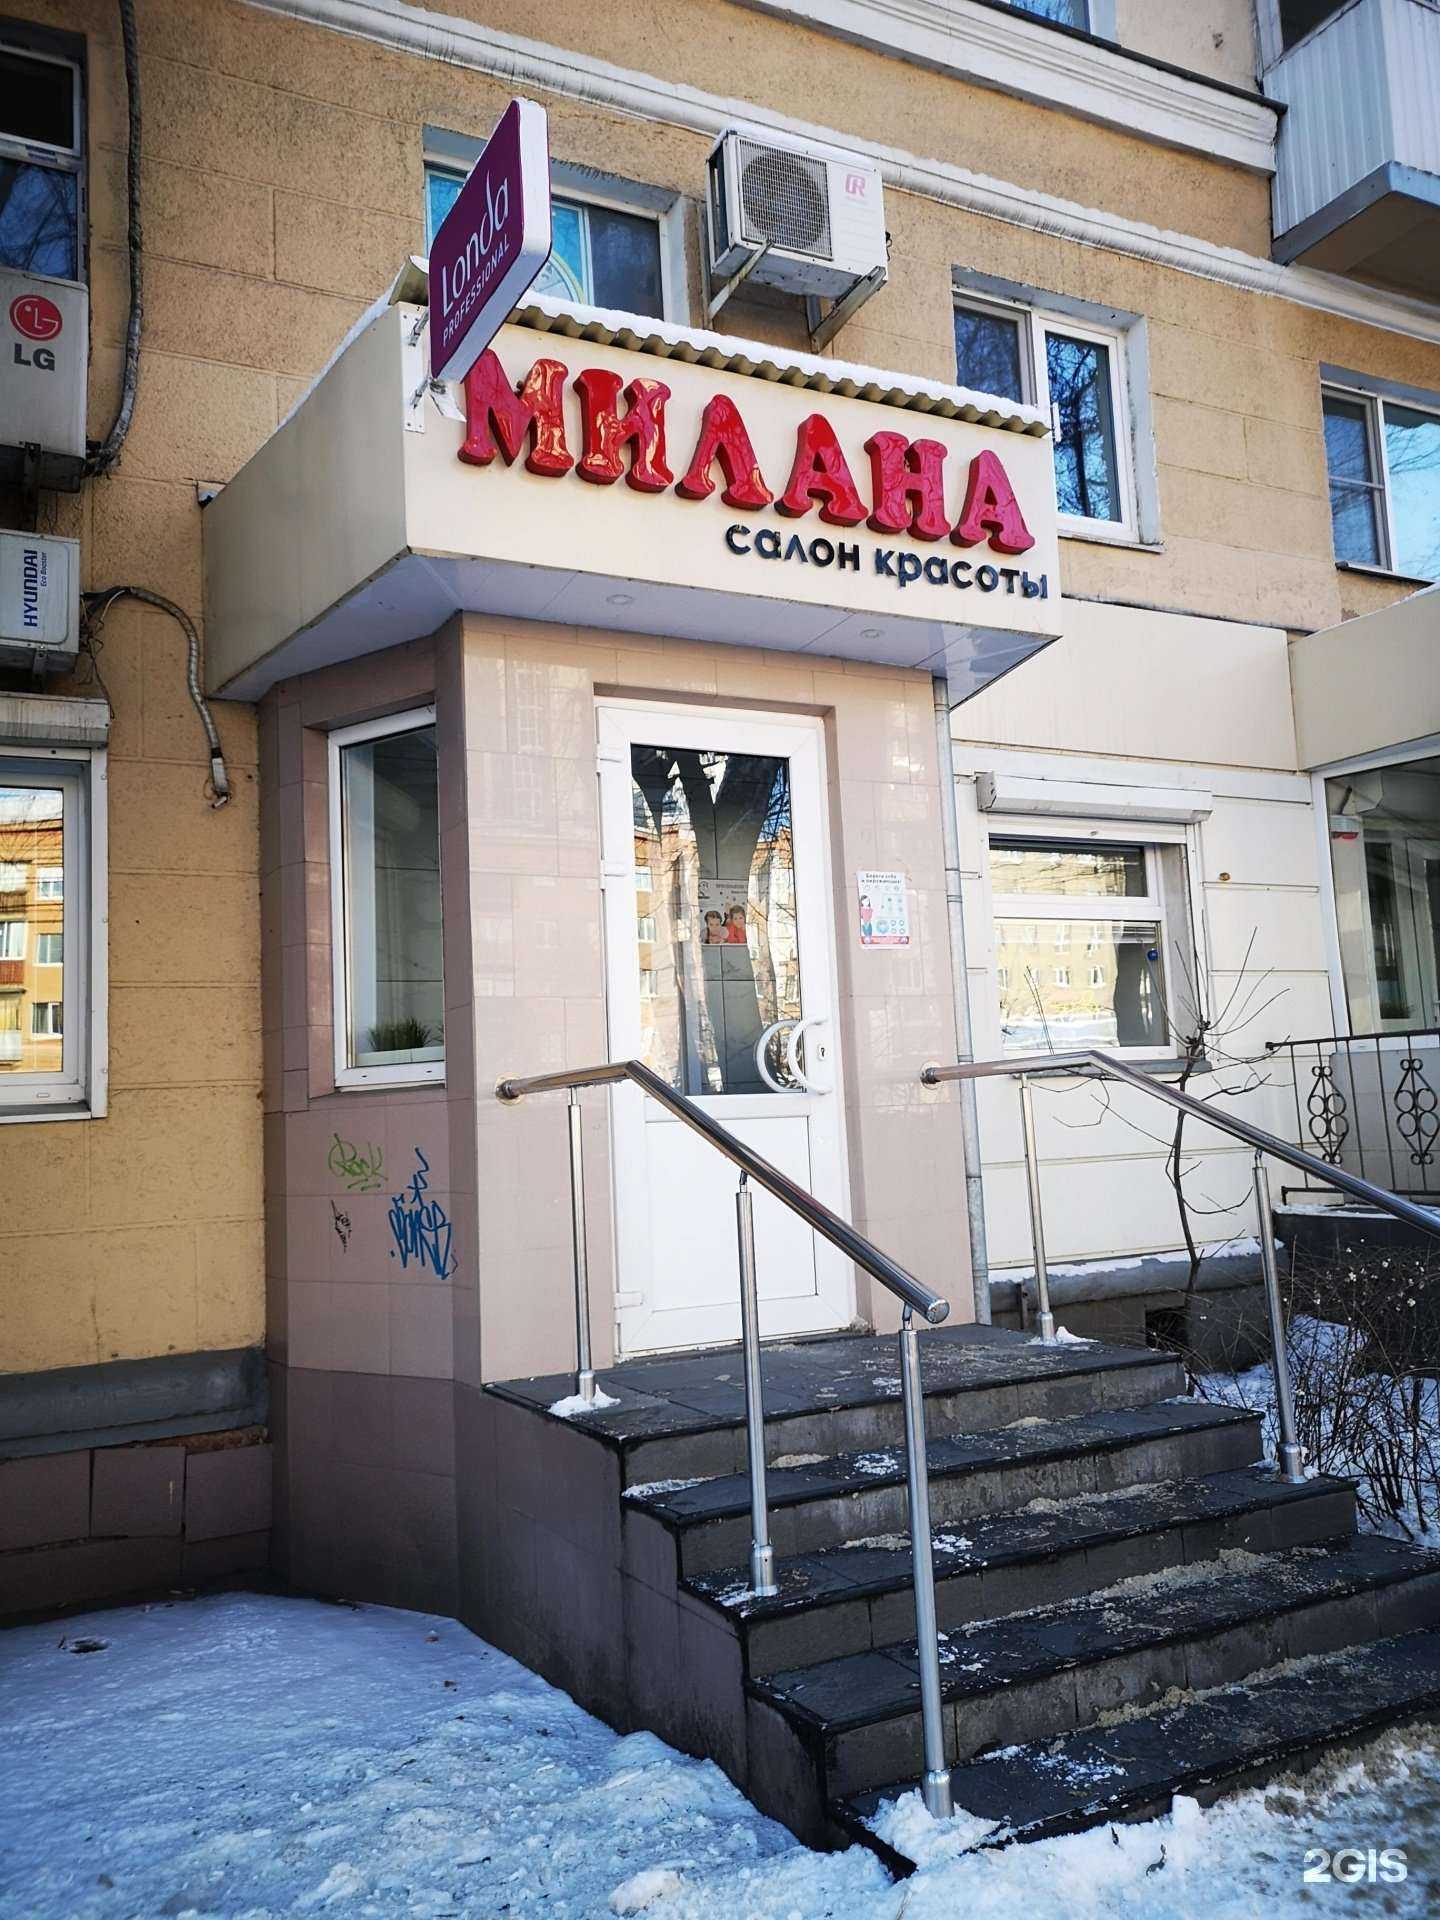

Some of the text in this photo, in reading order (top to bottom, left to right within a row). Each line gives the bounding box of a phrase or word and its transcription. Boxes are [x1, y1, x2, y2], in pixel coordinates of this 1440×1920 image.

[442, 170, 509, 318] Londa
[442, 234, 510, 347] PROFESSIONAL
[14, 343, 55, 371] LG
[457, 349, 1035, 556] МИЛАНА
[24, 549, 38, 627] HYUNDAI
[725, 524, 1048, 599] салон красоты
